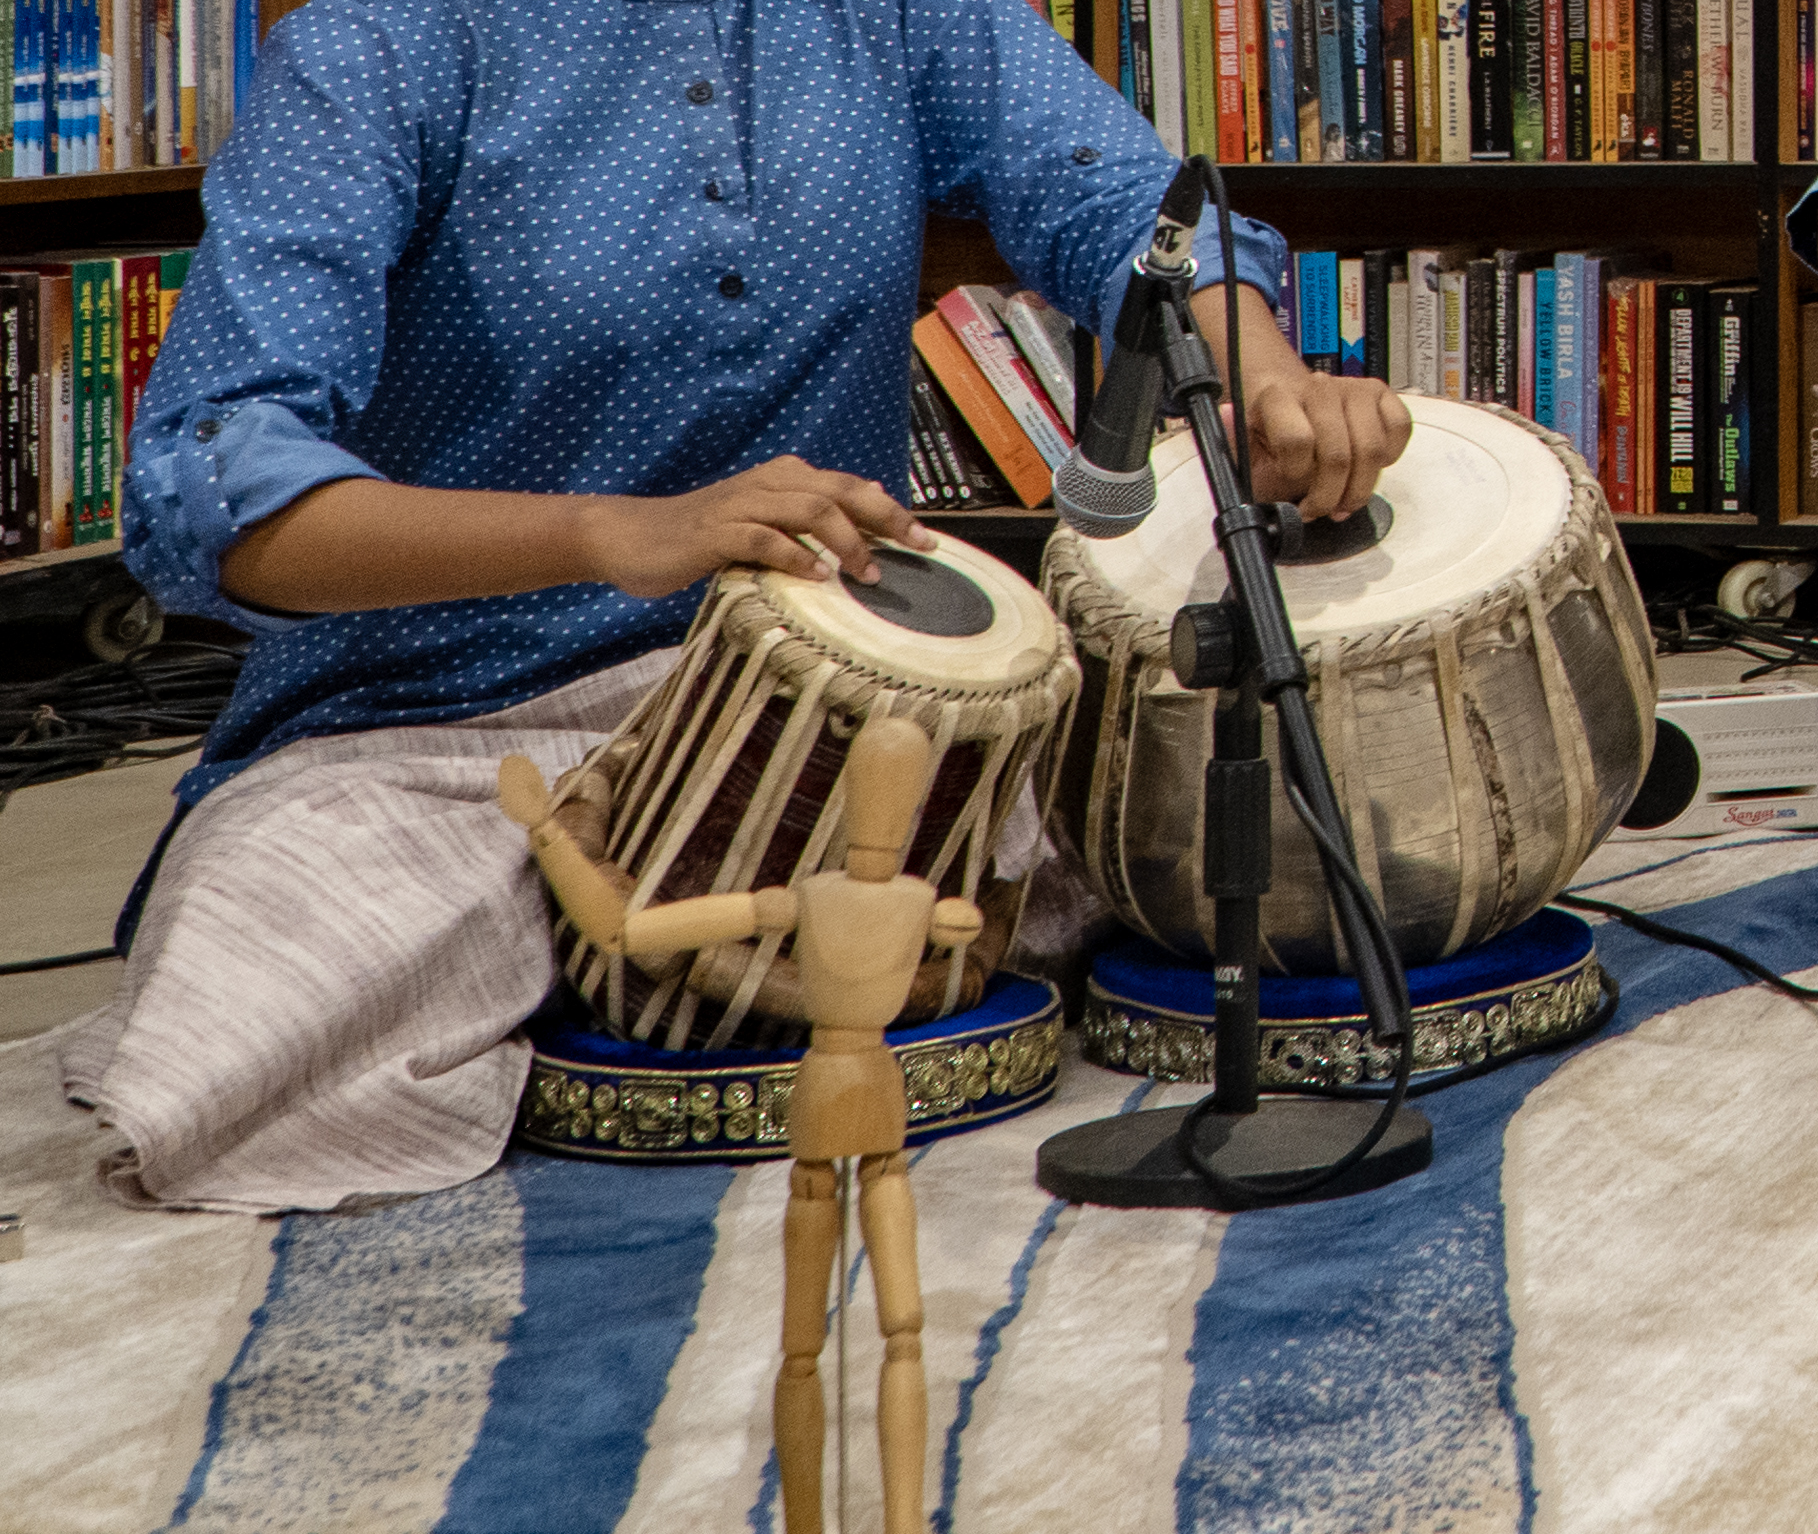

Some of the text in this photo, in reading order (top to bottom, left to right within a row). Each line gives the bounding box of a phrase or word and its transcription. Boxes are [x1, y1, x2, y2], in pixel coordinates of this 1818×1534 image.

[1525, 41, 1544, 127] BALDACCI
[1556, 265, 1576, 380] YASH BIRLA
[1723, 315, 1742, 377] Griffin
[1669, 395, 1694, 463] WILL HILL
[1722, 427, 1740, 493] Outlaws
